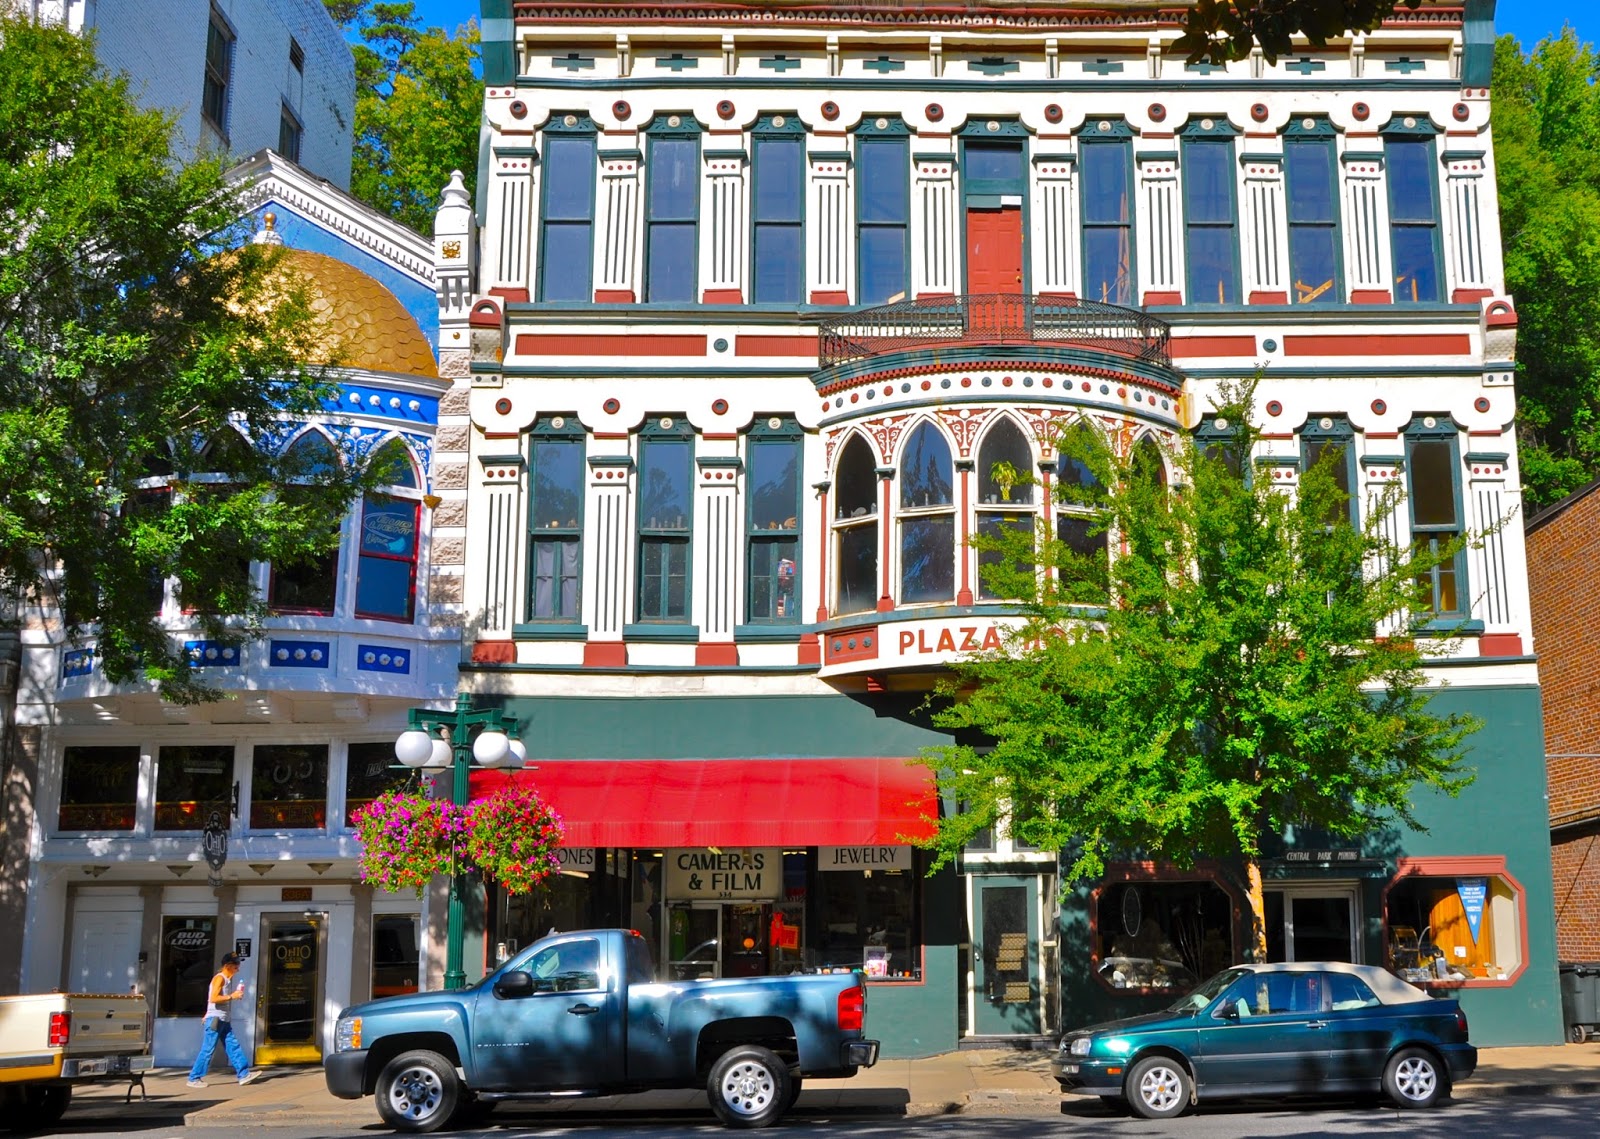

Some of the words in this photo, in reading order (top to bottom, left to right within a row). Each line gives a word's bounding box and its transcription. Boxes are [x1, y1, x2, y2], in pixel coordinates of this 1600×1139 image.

[899, 626, 1001, 655] PLAZA
[677, 853, 764, 871] CAMERAS
[833, 847, 897, 865] JEWELRY
[1286, 851, 1310, 861] CENTRAL
[1317, 851, 1333, 861] PARK
[688, 873, 703, 890] &
[712, 873, 761, 891] FILM
[170, 938, 211, 946] LIGHT
[177, 931, 206, 939] BUD
[276, 945, 312, 960] OHIO
